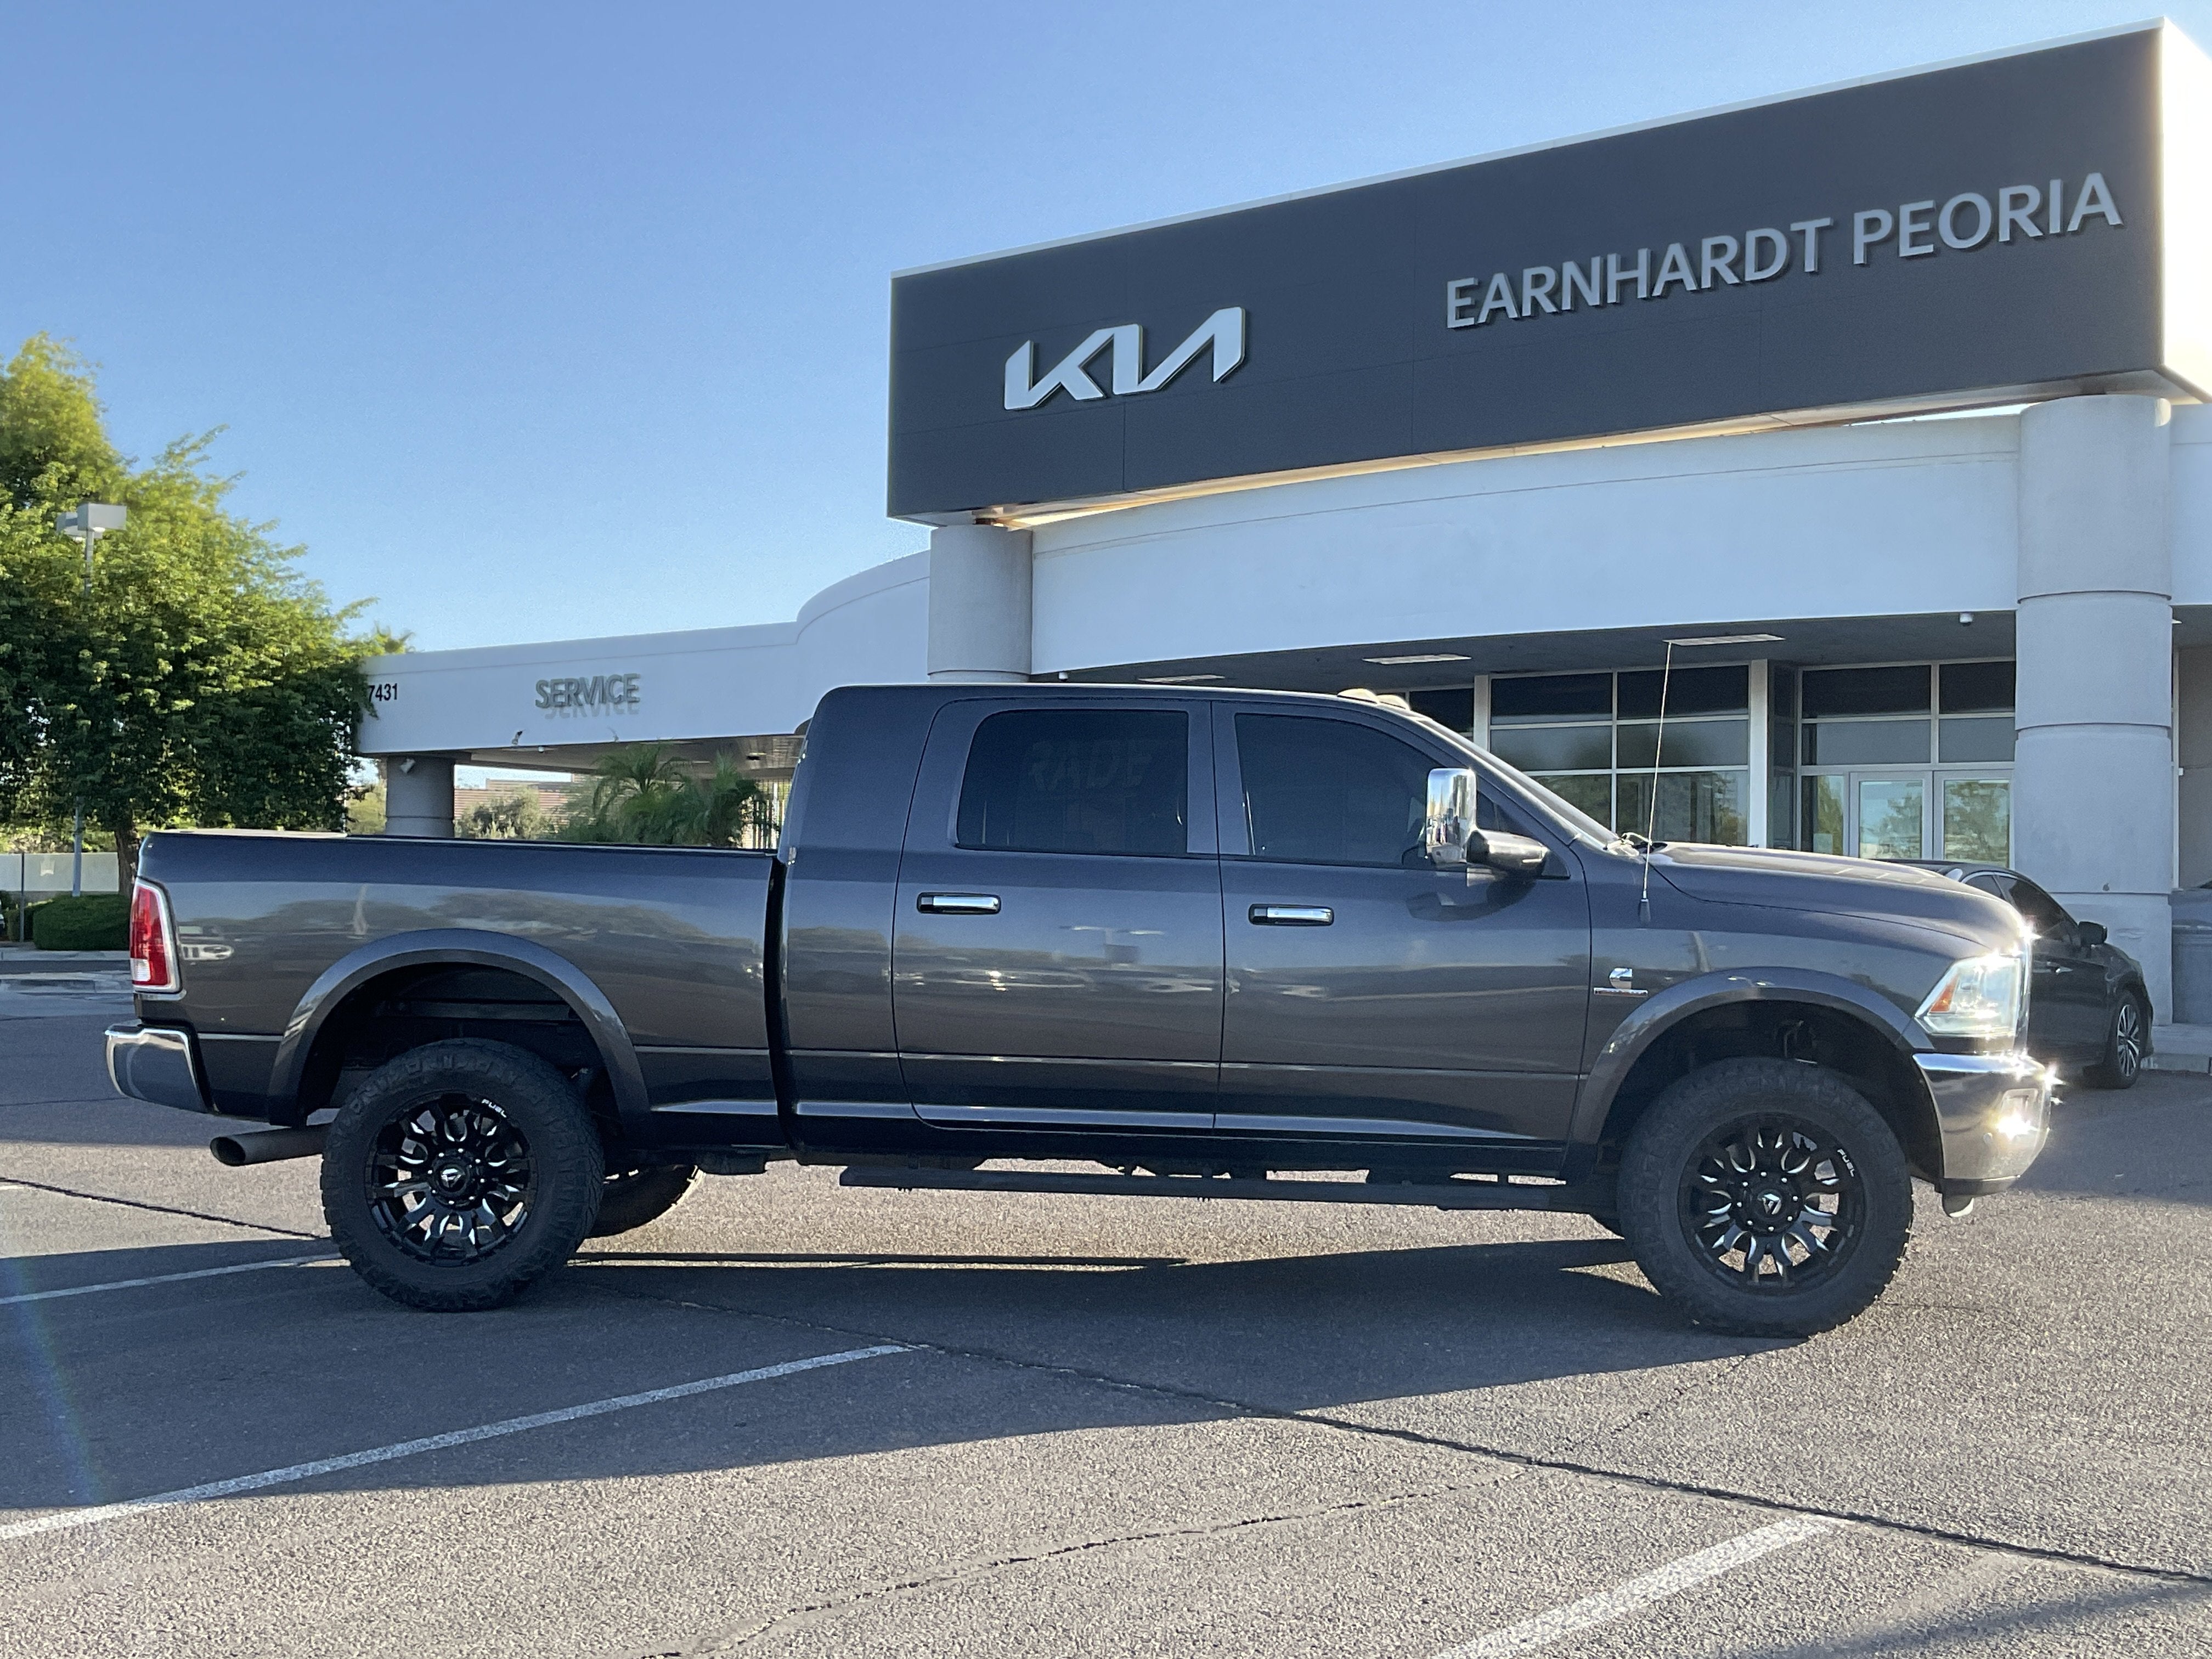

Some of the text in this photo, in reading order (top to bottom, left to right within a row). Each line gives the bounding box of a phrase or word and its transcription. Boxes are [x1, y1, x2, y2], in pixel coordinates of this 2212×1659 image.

[1447, 172, 2124, 329] EARNHARDT PEORIA
[1004, 306, 1245, 410] KIA
[535, 673, 641, 709] SERVICE
[481, 1098, 507, 1118] FUEL
[1837, 1148, 1855, 1177] FUEL
